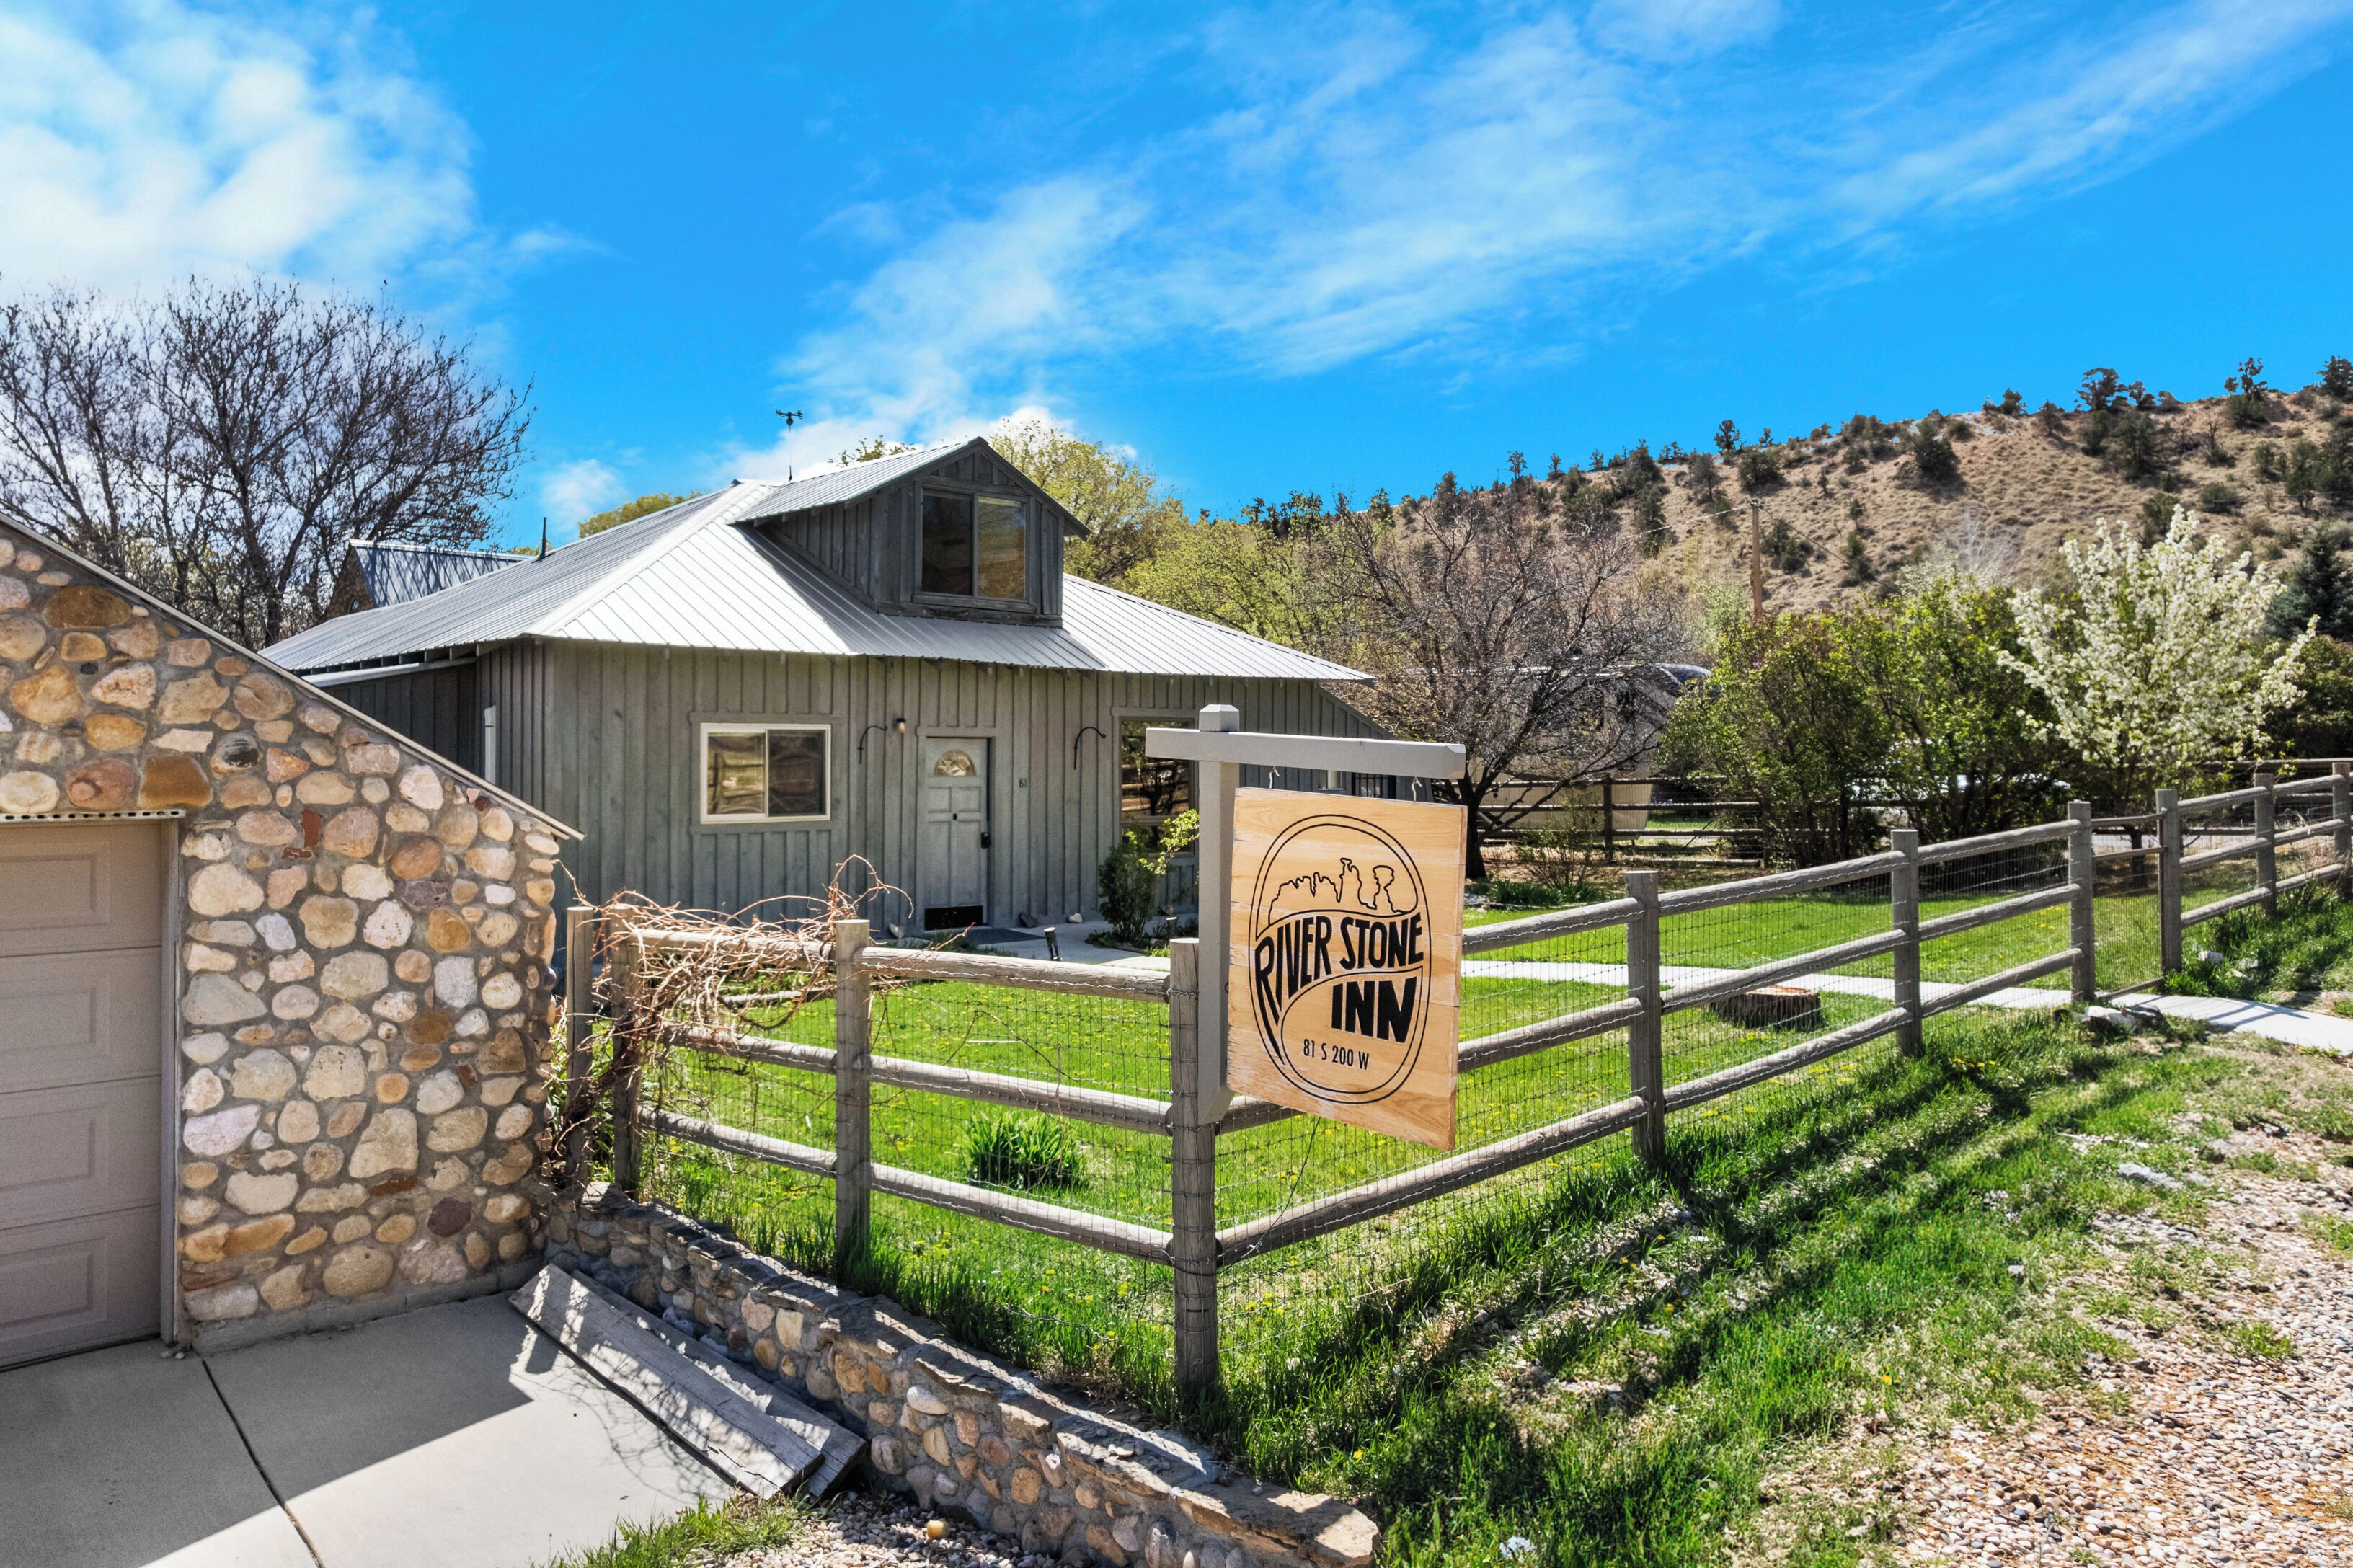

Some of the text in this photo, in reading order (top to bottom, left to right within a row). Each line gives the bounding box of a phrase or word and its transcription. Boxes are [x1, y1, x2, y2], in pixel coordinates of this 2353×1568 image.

[1254, 911, 1424, 1065] RIVER STONE
[1331, 976, 1417, 1044] INN
[1303, 1039, 1370, 1071] 81 S 200 W
